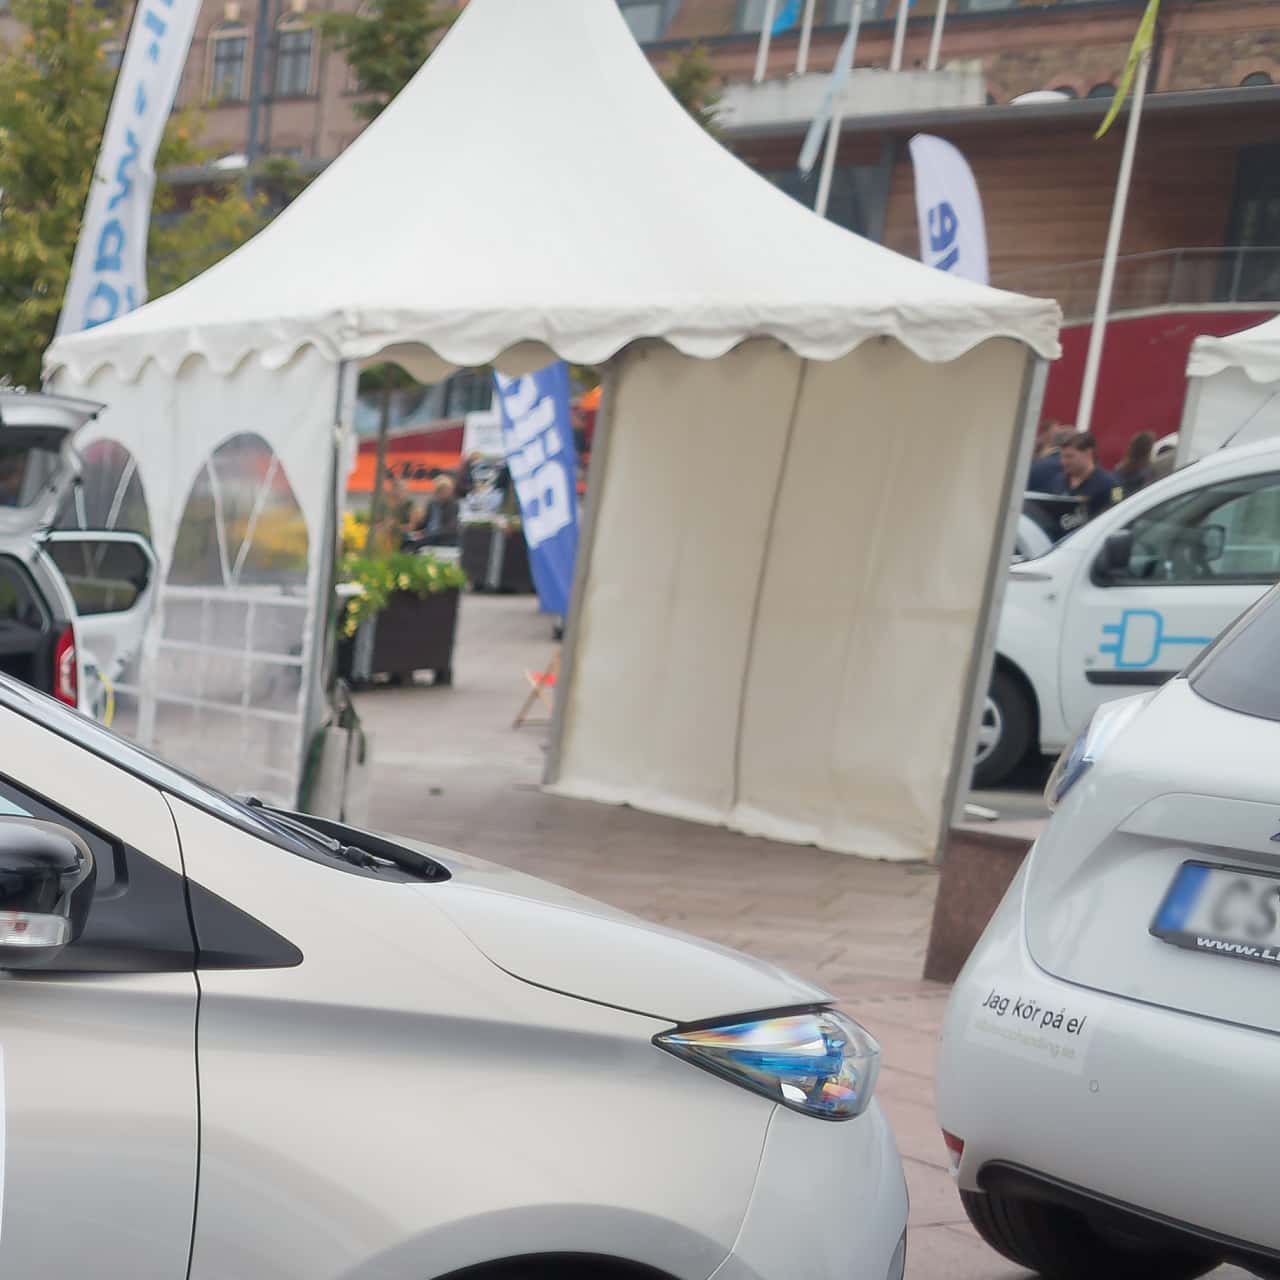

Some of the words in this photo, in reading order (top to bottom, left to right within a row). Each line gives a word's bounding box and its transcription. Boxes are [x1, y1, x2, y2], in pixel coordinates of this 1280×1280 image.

[982, 988, 1010, 1016] Jag
[1012, 996, 1041, 1021] kör
[1040, 1007, 1066, 1029] på
[1066, 1016, 1088, 1035] el
